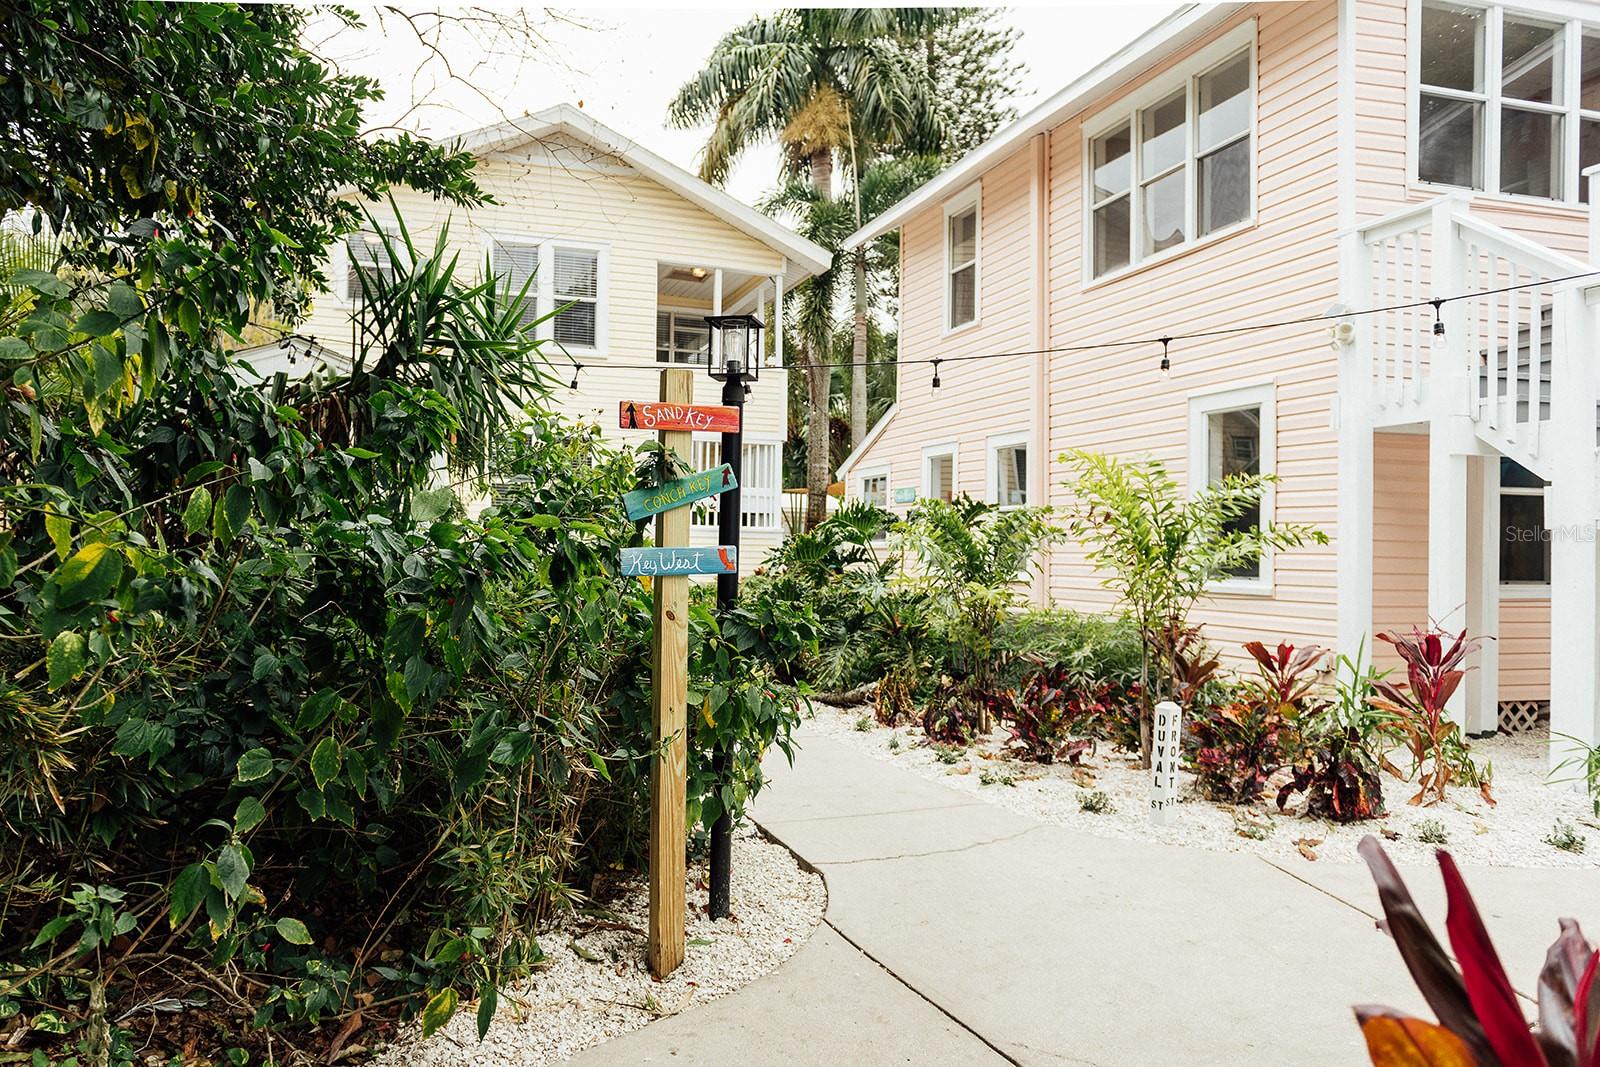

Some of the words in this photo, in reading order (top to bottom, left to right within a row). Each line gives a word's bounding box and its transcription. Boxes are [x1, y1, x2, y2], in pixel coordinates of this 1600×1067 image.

[642, 405, 684, 428] SAND
[685, 407, 714, 430] KEY
[642, 487, 687, 513] CONCH
[689, 475, 711, 494] KEY
[627, 551, 657, 576] Key
[658, 550, 705, 573] West
[1154, 714, 1166, 788] DUVAL
[1169, 714, 1178, 789] FRONT
[1151, 799, 1163, 811] ST
[1165, 797, 1175, 807] ST
